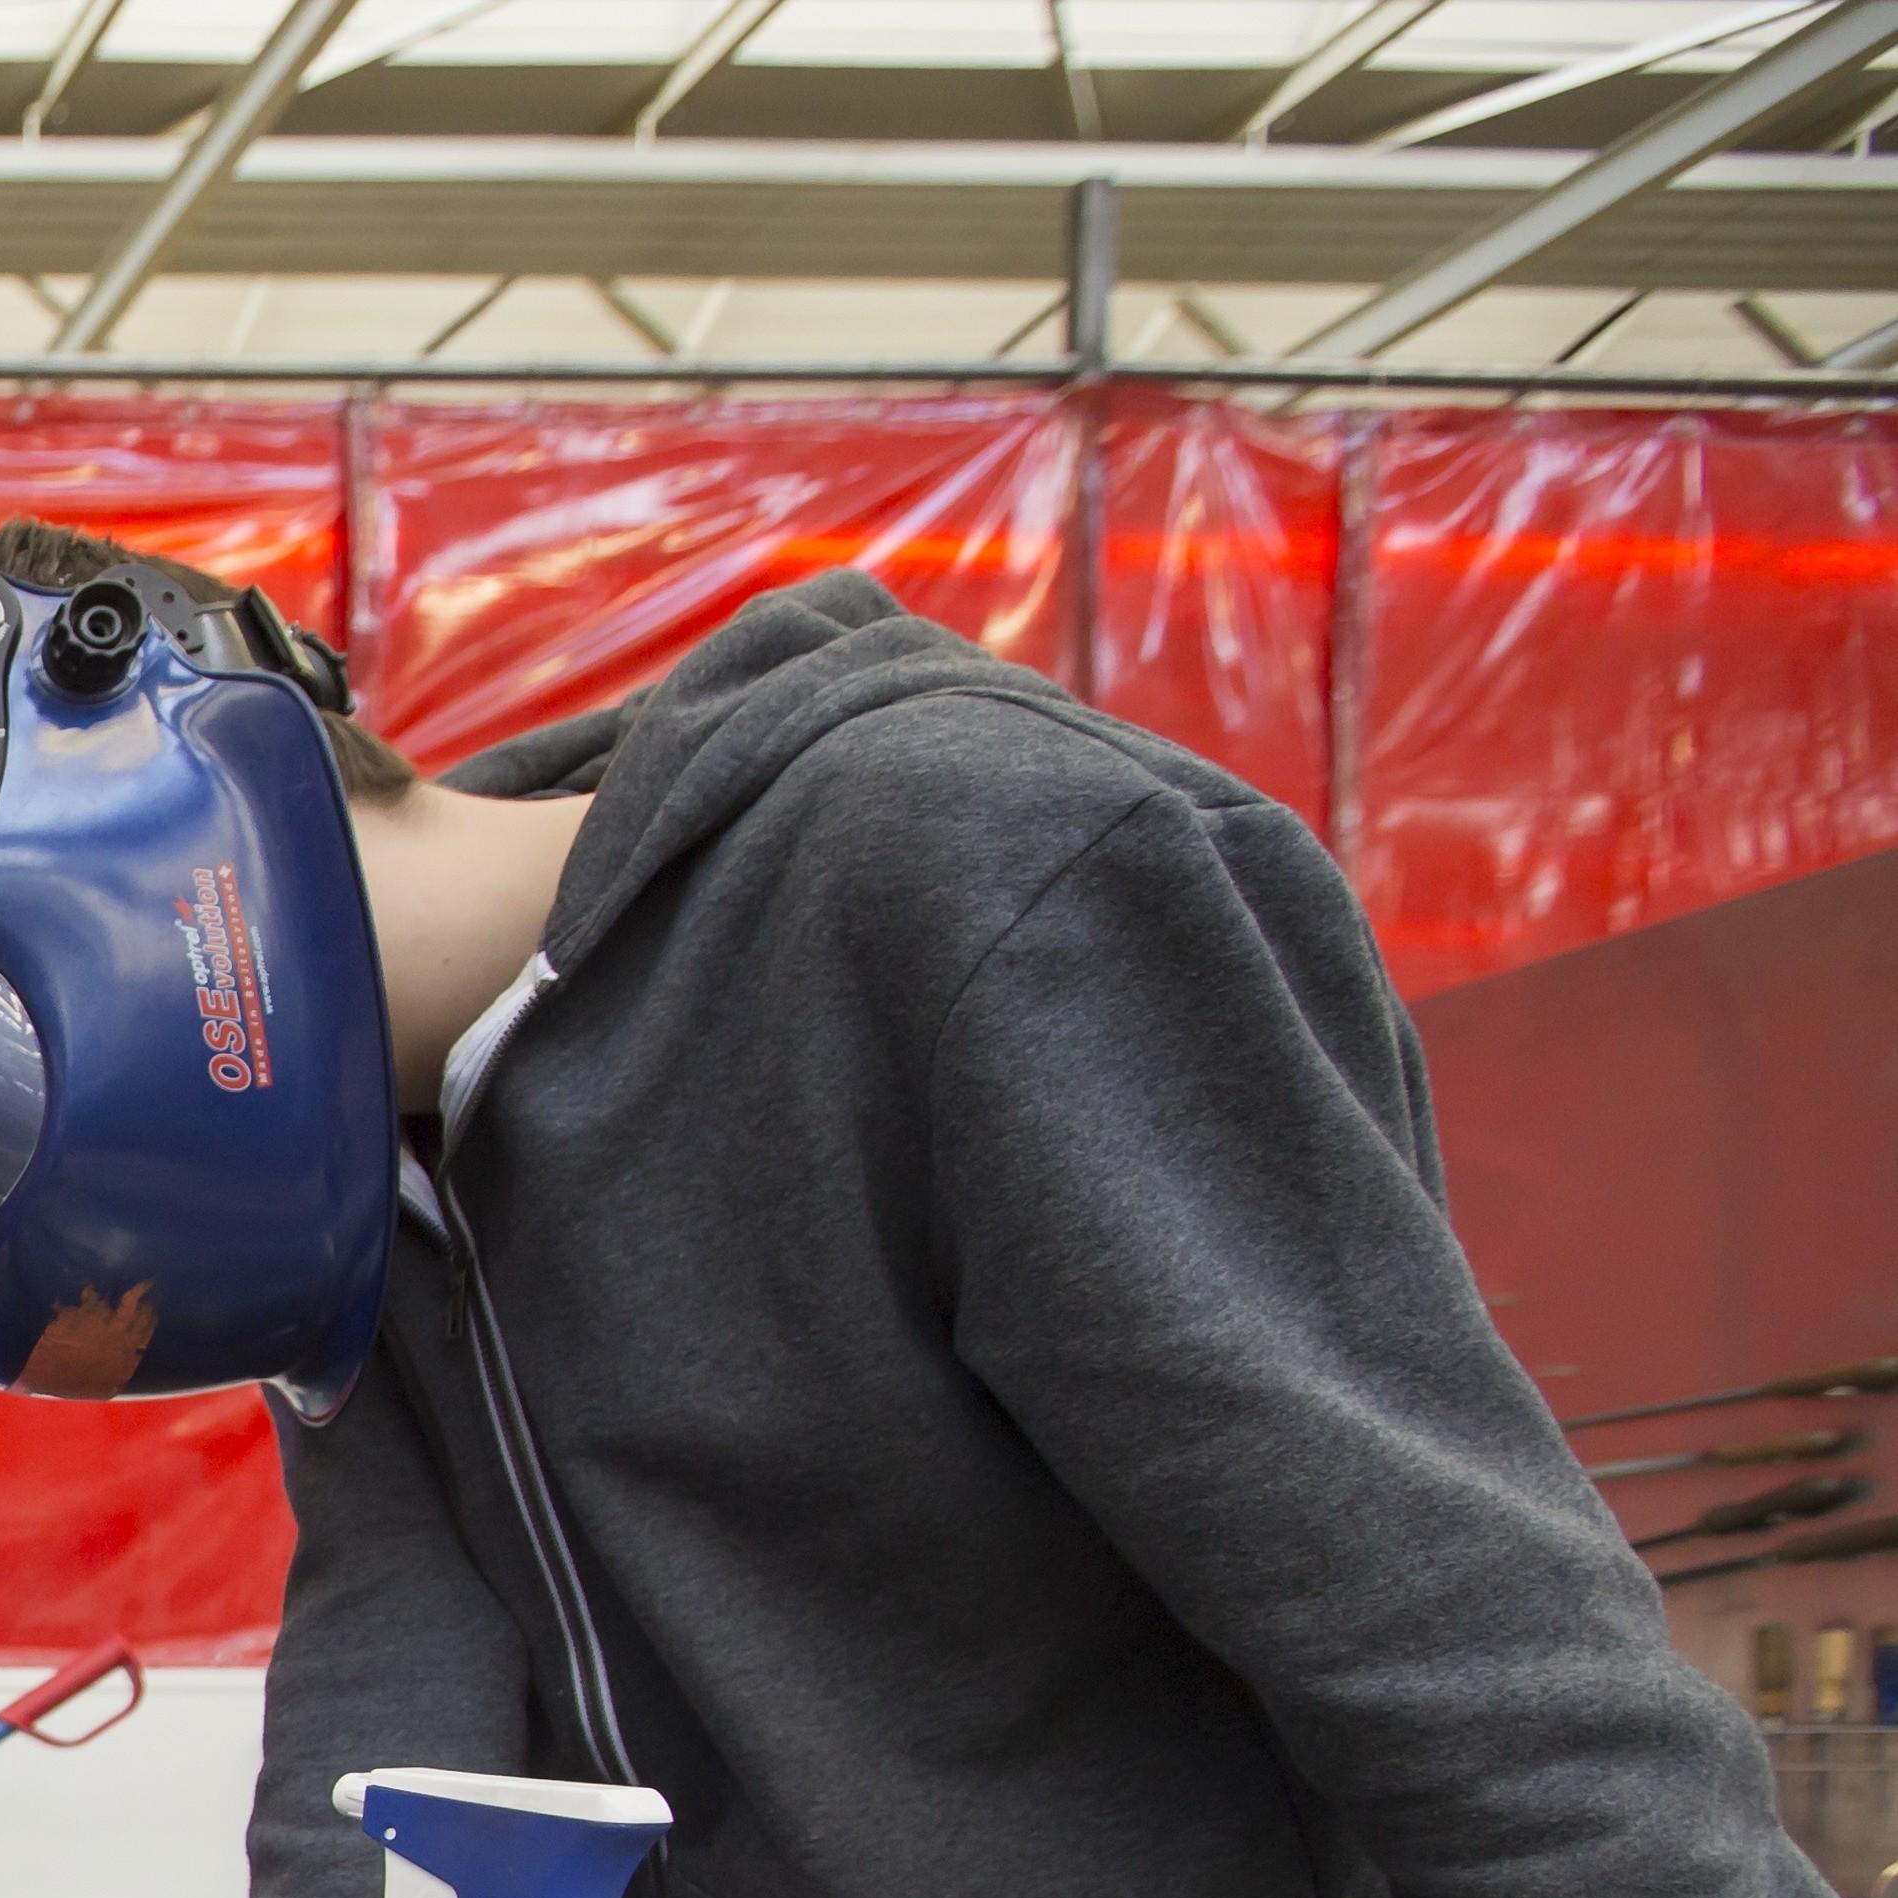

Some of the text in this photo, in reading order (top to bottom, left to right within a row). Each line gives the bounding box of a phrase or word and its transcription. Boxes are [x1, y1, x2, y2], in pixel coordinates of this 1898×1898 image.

[224, 881, 255, 999] Switzerland
[250, 925, 275, 1015] www.optrel.com
[255, 1037, 270, 1085] Made
